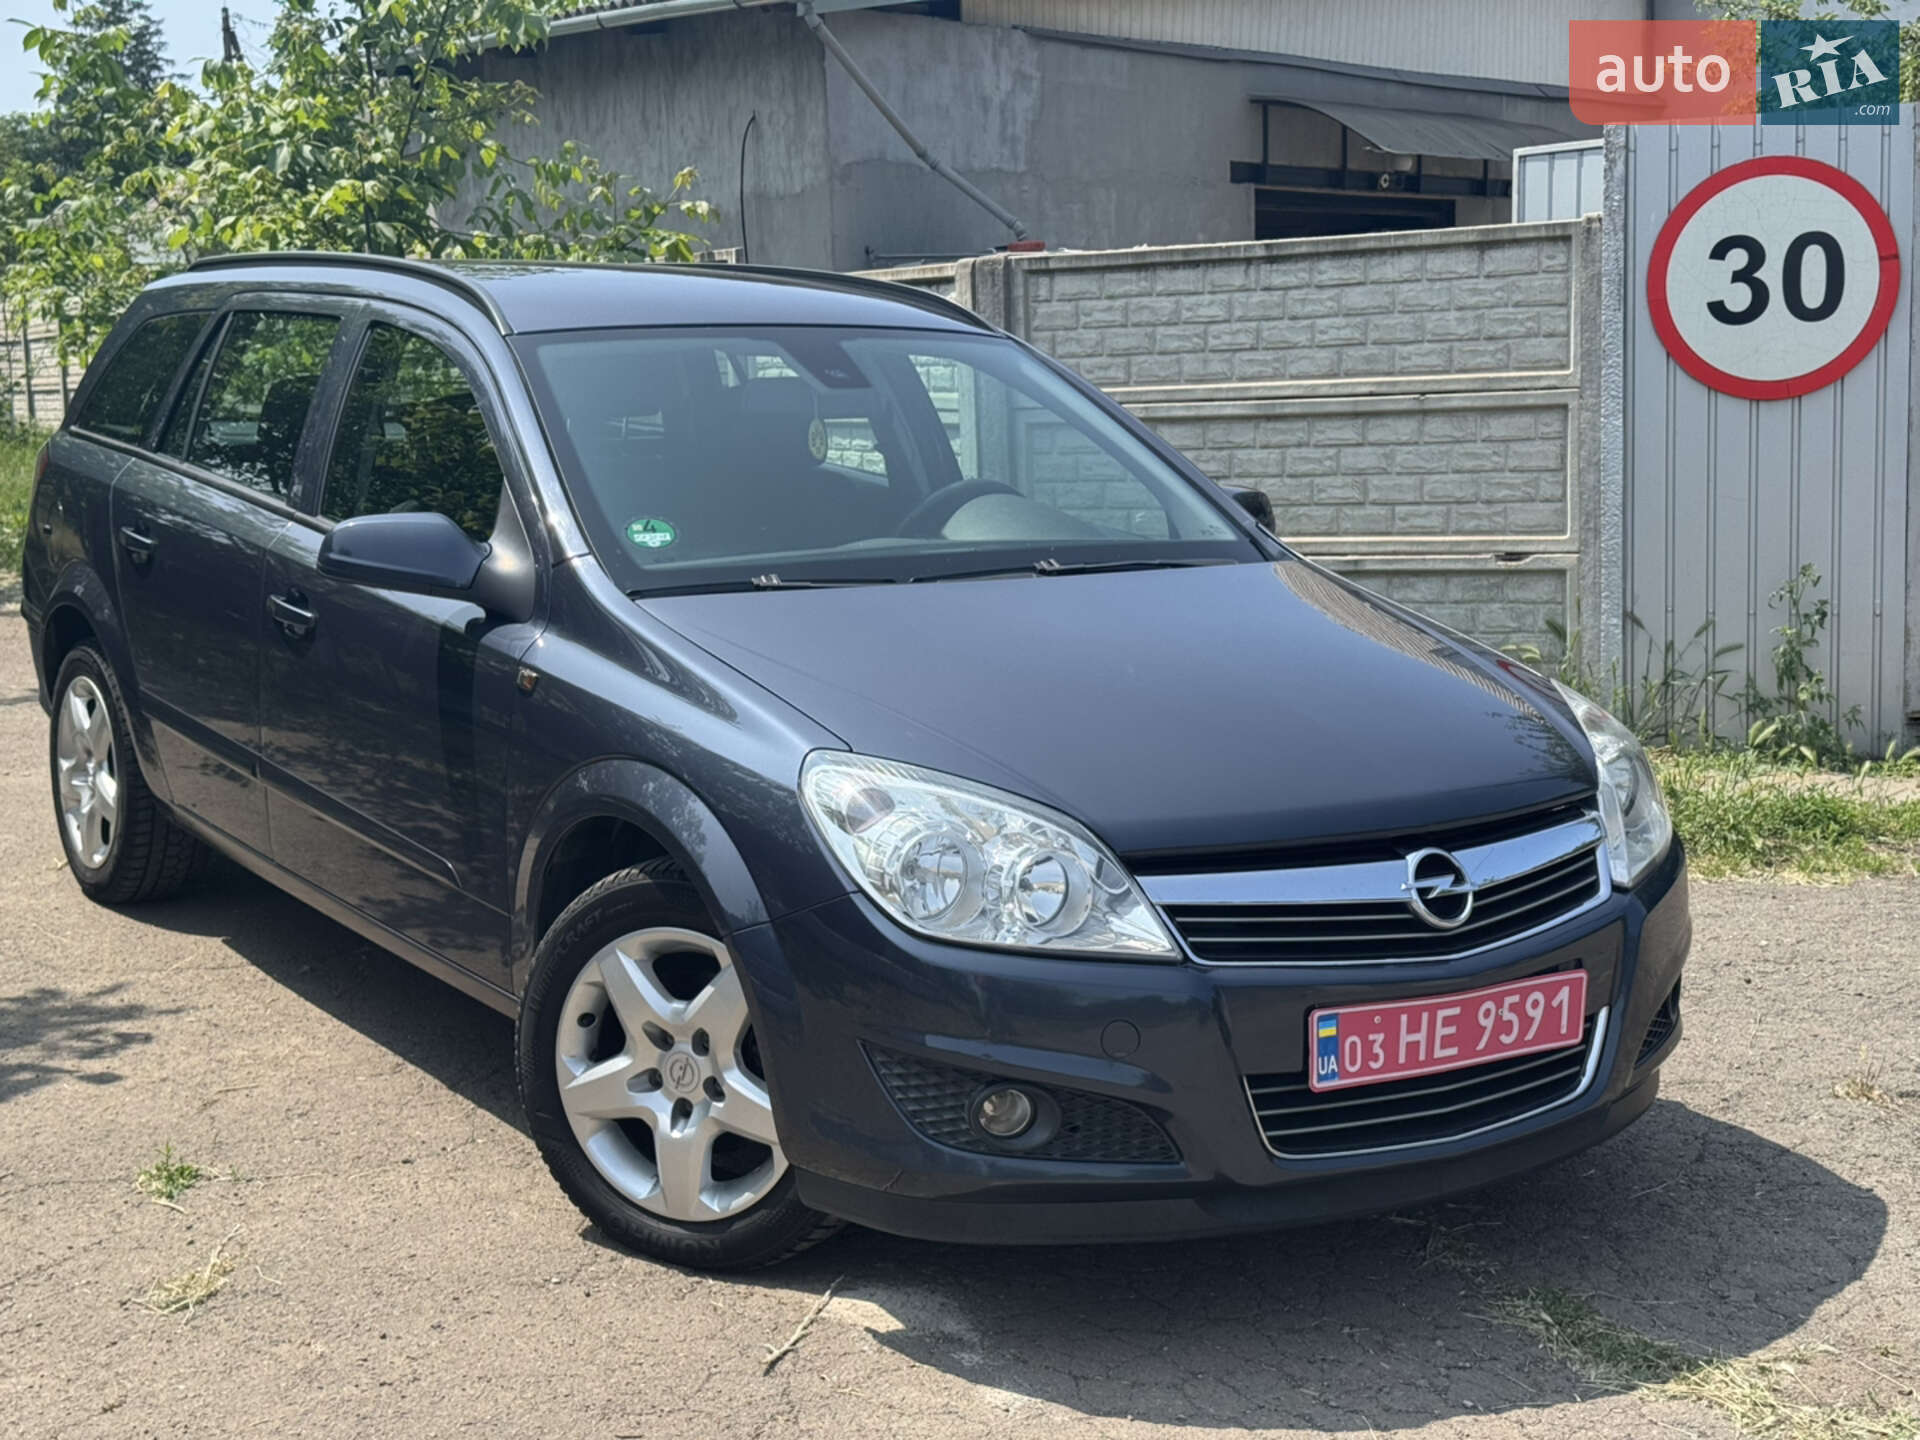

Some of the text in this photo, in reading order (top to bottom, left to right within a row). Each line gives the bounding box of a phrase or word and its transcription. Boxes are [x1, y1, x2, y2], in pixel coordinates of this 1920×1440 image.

[1706, 230, 1846, 326] 30
[1318, 1055, 1338, 1076] UA
[1344, 985, 1570, 1073] 03 HE 9591
